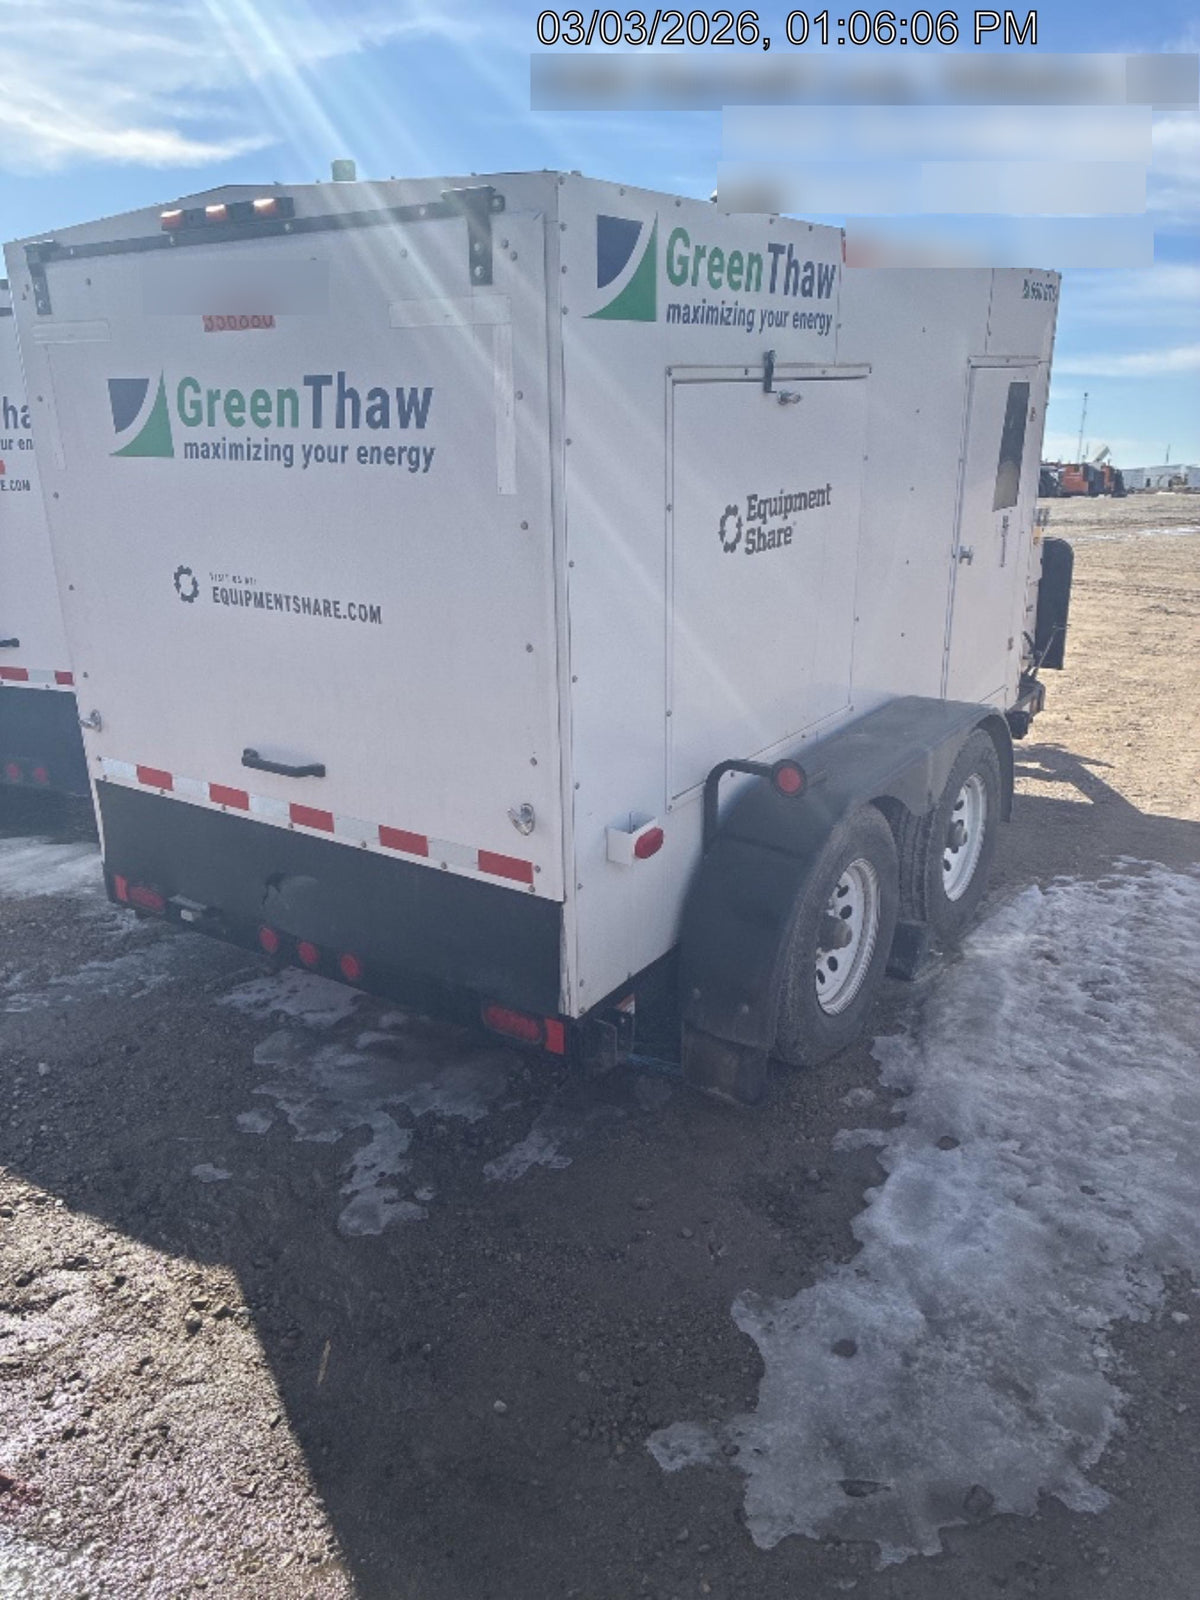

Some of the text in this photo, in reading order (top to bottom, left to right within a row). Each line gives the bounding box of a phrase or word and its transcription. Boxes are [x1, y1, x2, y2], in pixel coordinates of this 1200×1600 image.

[666, 226, 836, 300] GreenThaw
[666, 299, 833, 337] maximizing your energy
[177, 371, 434, 430] GreenThaw
[184, 437, 436, 474] maximizing your energy
[746, 483, 833, 526] Equipment
[745, 526, 793, 555] Share
[212, 586, 383, 625] EQUIPMENTSHARE.COM
